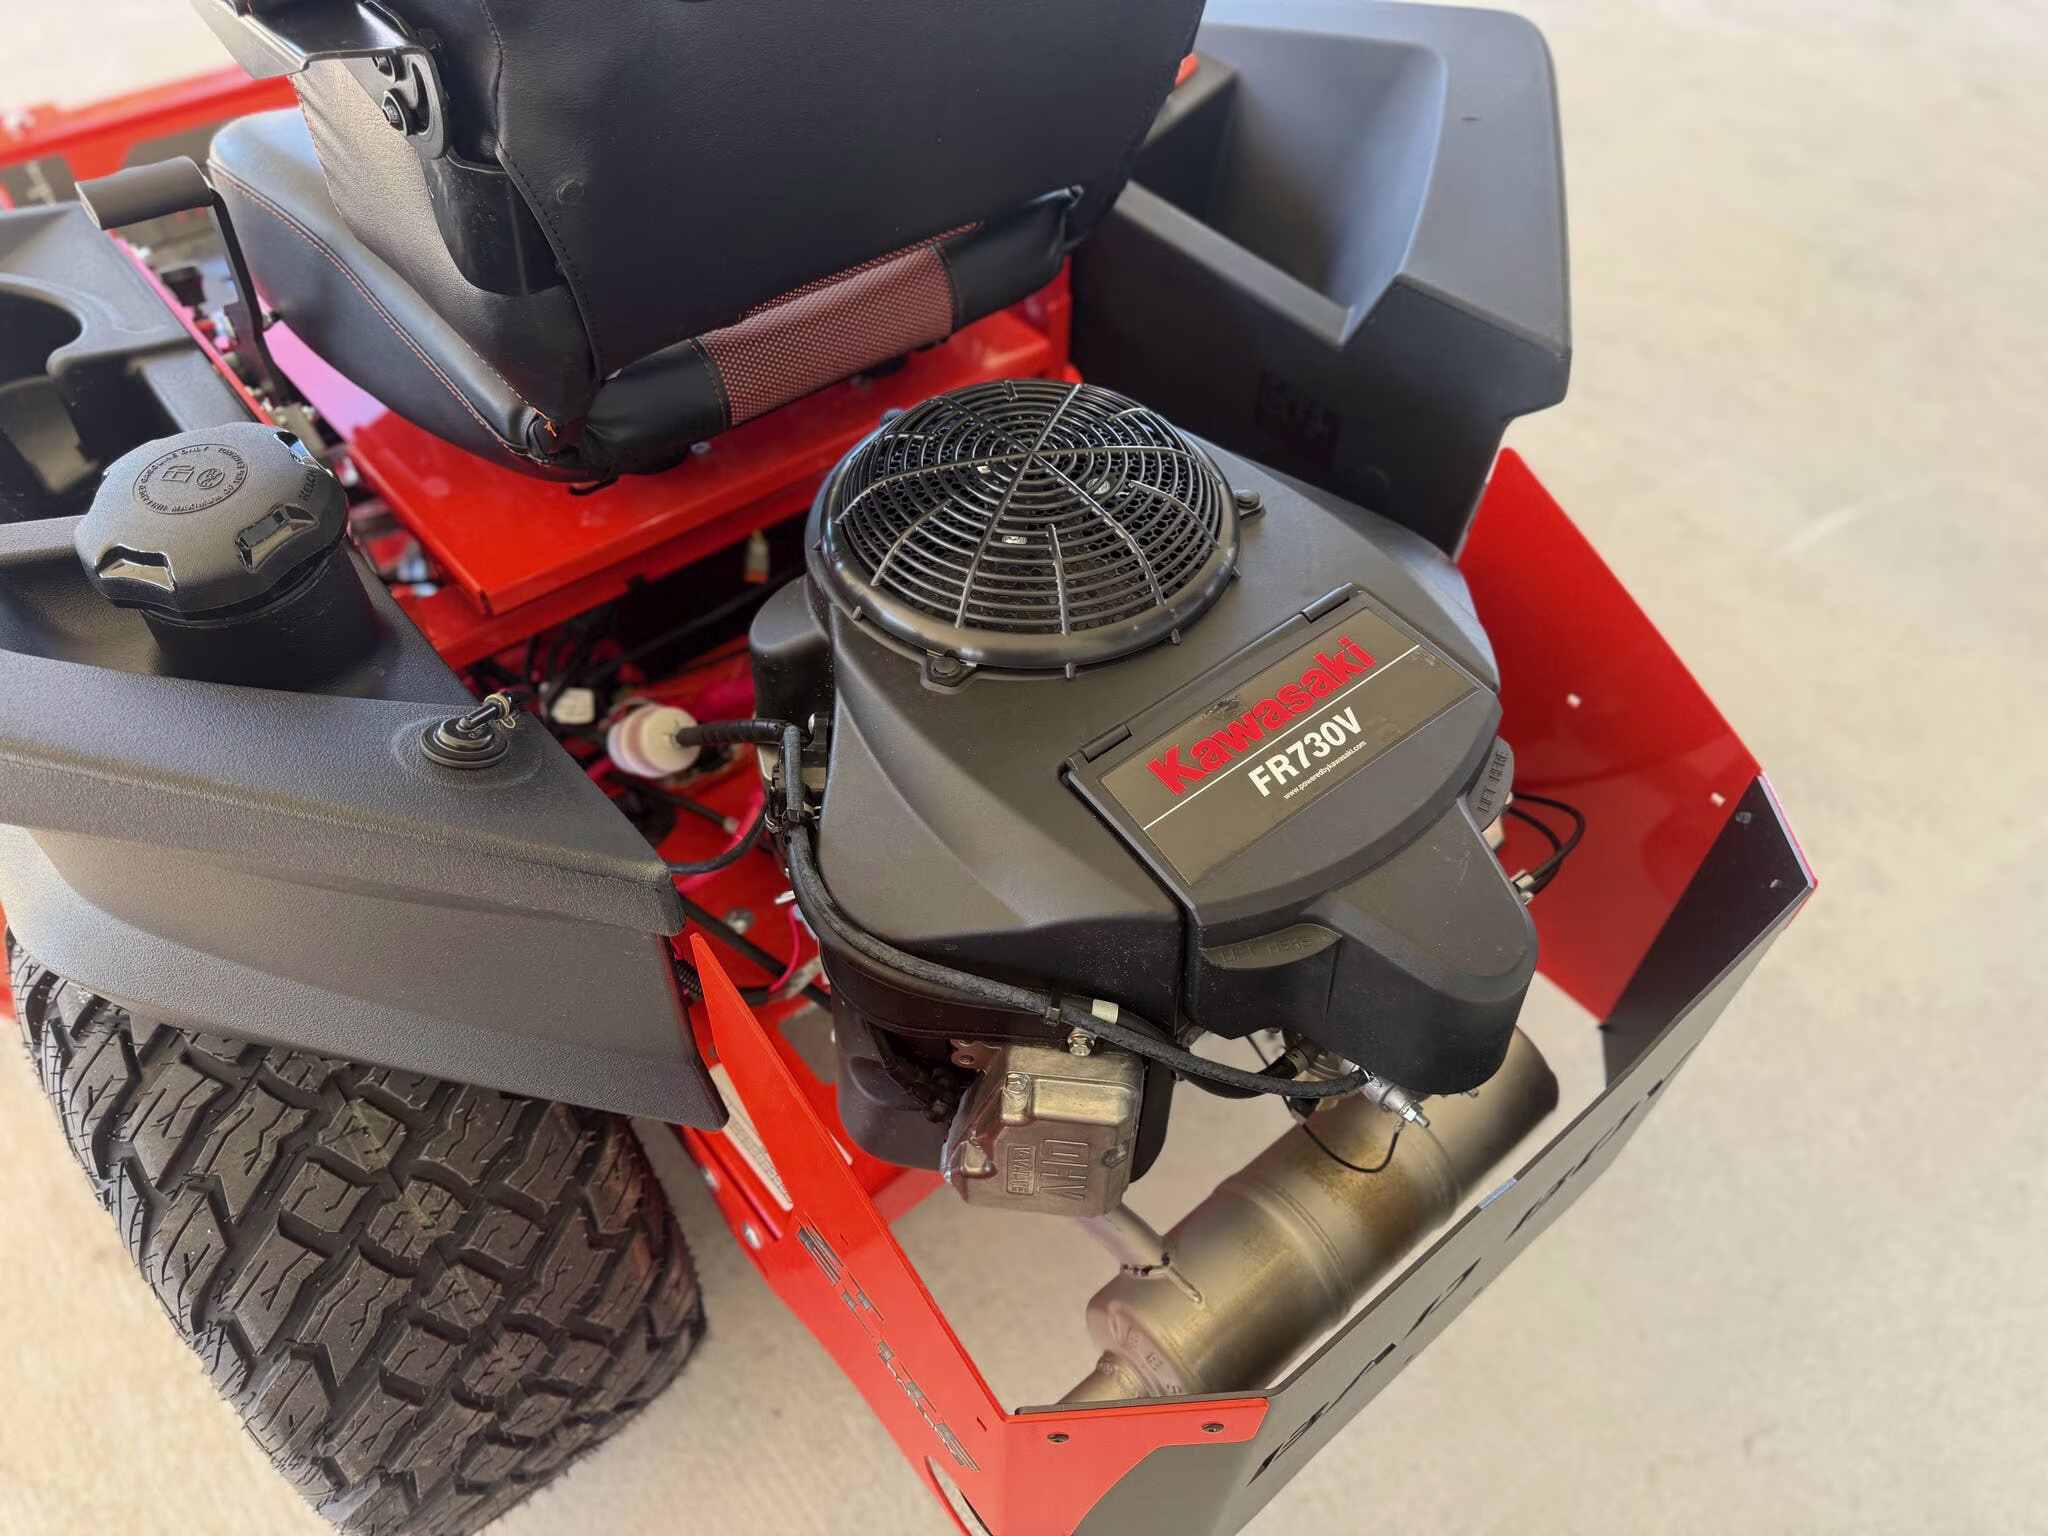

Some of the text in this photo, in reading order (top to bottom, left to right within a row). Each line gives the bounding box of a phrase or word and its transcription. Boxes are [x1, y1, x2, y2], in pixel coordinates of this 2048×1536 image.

[1145, 635, 1378, 796] Kawasaki
[1247, 706, 1362, 798] FR730V
[1283, 740, 1368, 800] www.poweredbykawasaki.com
[1477, 750, 1510, 814] LIFT HERE
[1039, 1139, 1090, 1201] OHV
